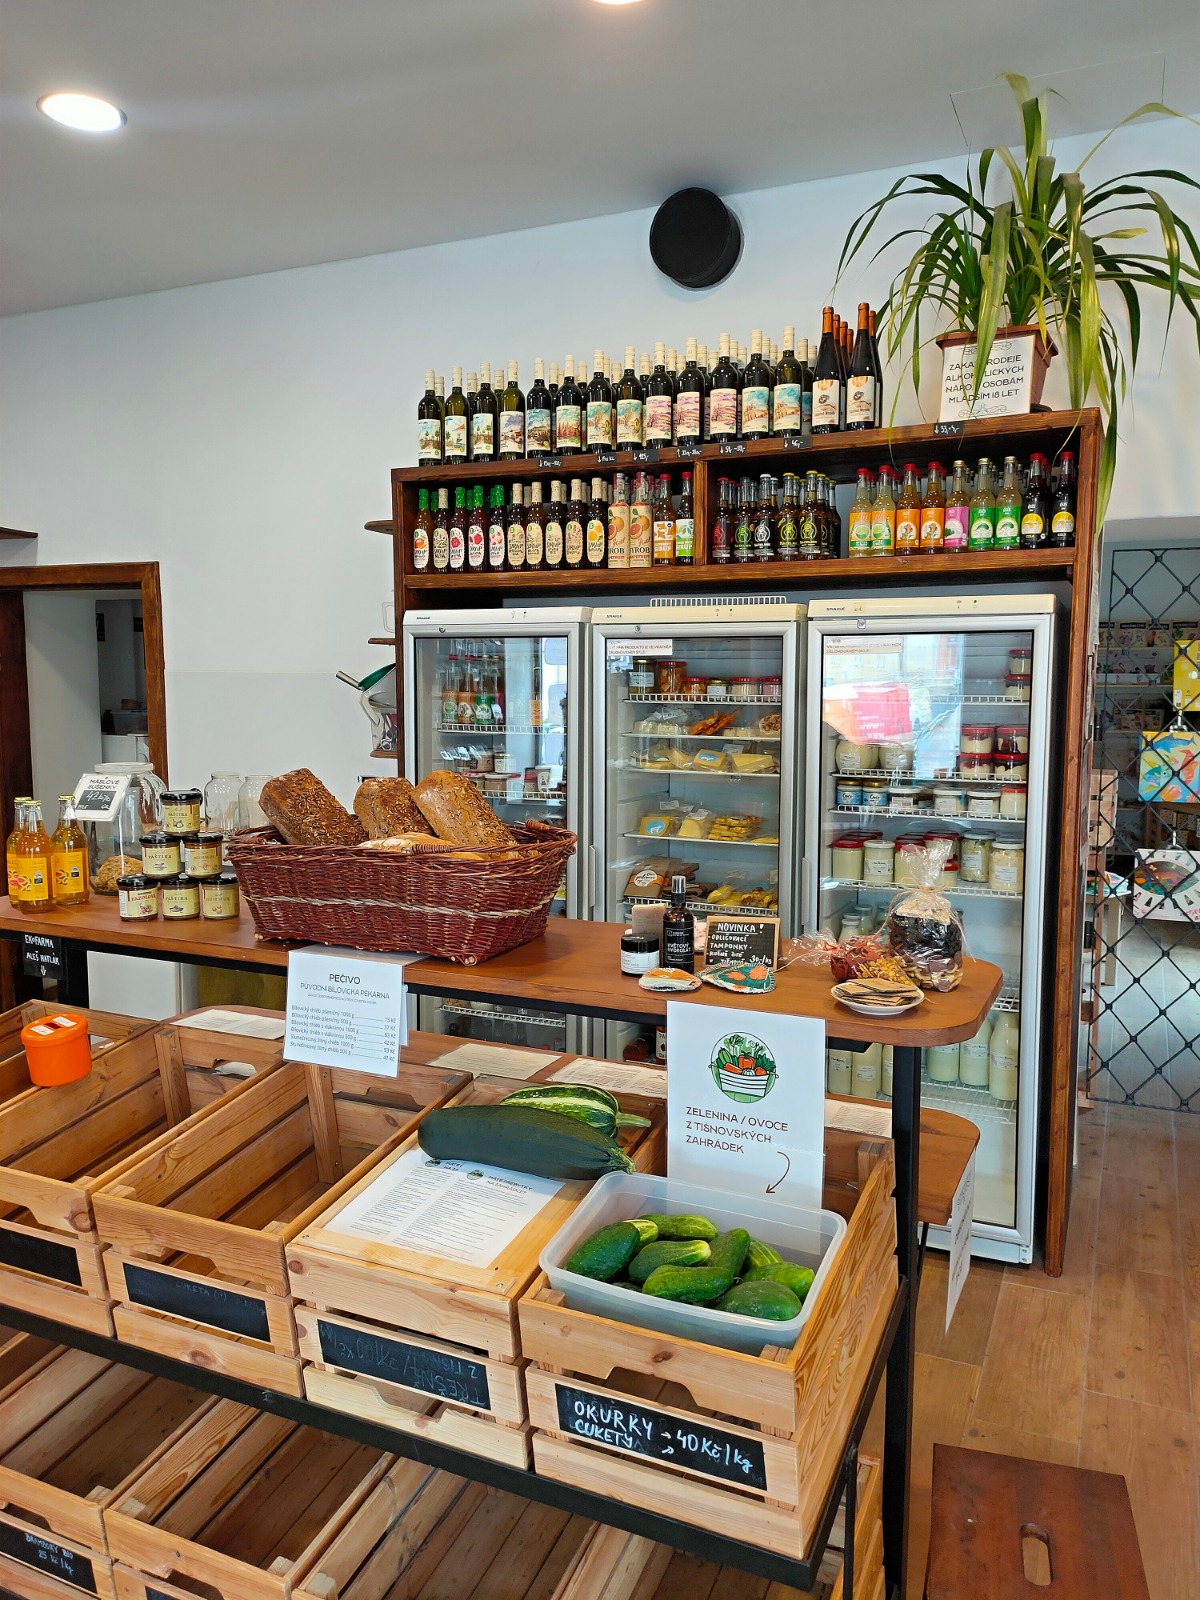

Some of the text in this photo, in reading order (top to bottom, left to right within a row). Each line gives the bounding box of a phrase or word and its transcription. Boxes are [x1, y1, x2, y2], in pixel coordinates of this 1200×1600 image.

[949, 354, 1022, 370] ZÁKA RODEJE
[992, 390, 1000, 398] 18
[1002, 388, 1020, 398] LET
[718, 923, 756, 932] NOVINKA
[26, 950, 40, 962] ALEŠ
[328, 973, 361, 985] PEČIVO
[686, 1106, 788, 1132] ZELENINA / OVOCE
[686, 1120, 772, 1143] Z TIŠNOVSKÝCH
[686, 1134, 744, 1154] ZAHRÁDEK
[574, 1401, 653, 1440] OKURKY
[574, 1418, 633, 1448] CUKETY
